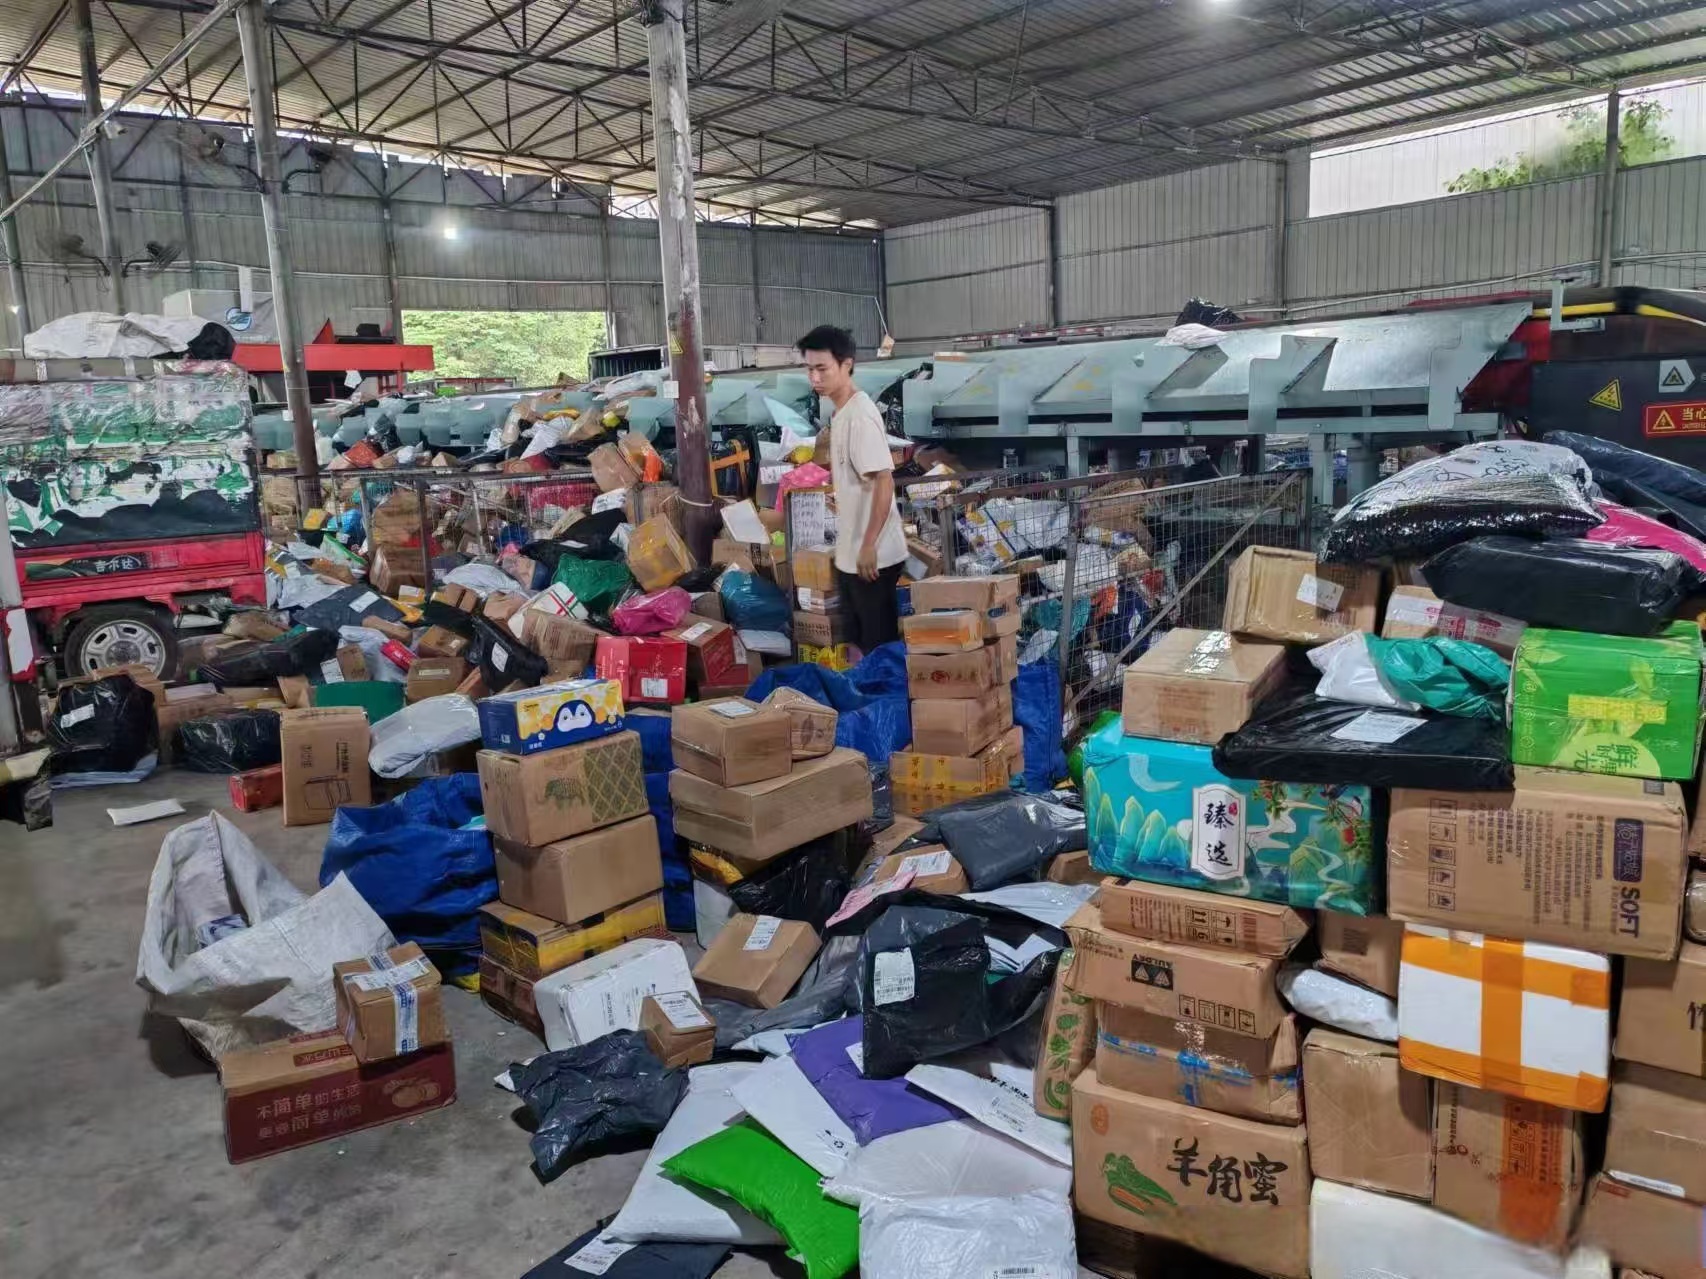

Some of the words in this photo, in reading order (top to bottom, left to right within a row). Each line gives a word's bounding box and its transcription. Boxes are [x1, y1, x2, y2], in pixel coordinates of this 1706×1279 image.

[1681, 407, 1706, 421] 当心
[1203, 800, 1235, 867] 臻选
[1618, 885, 1641, 939] SOFT
[1166, 1135, 1289, 1206] 羊角蜜
